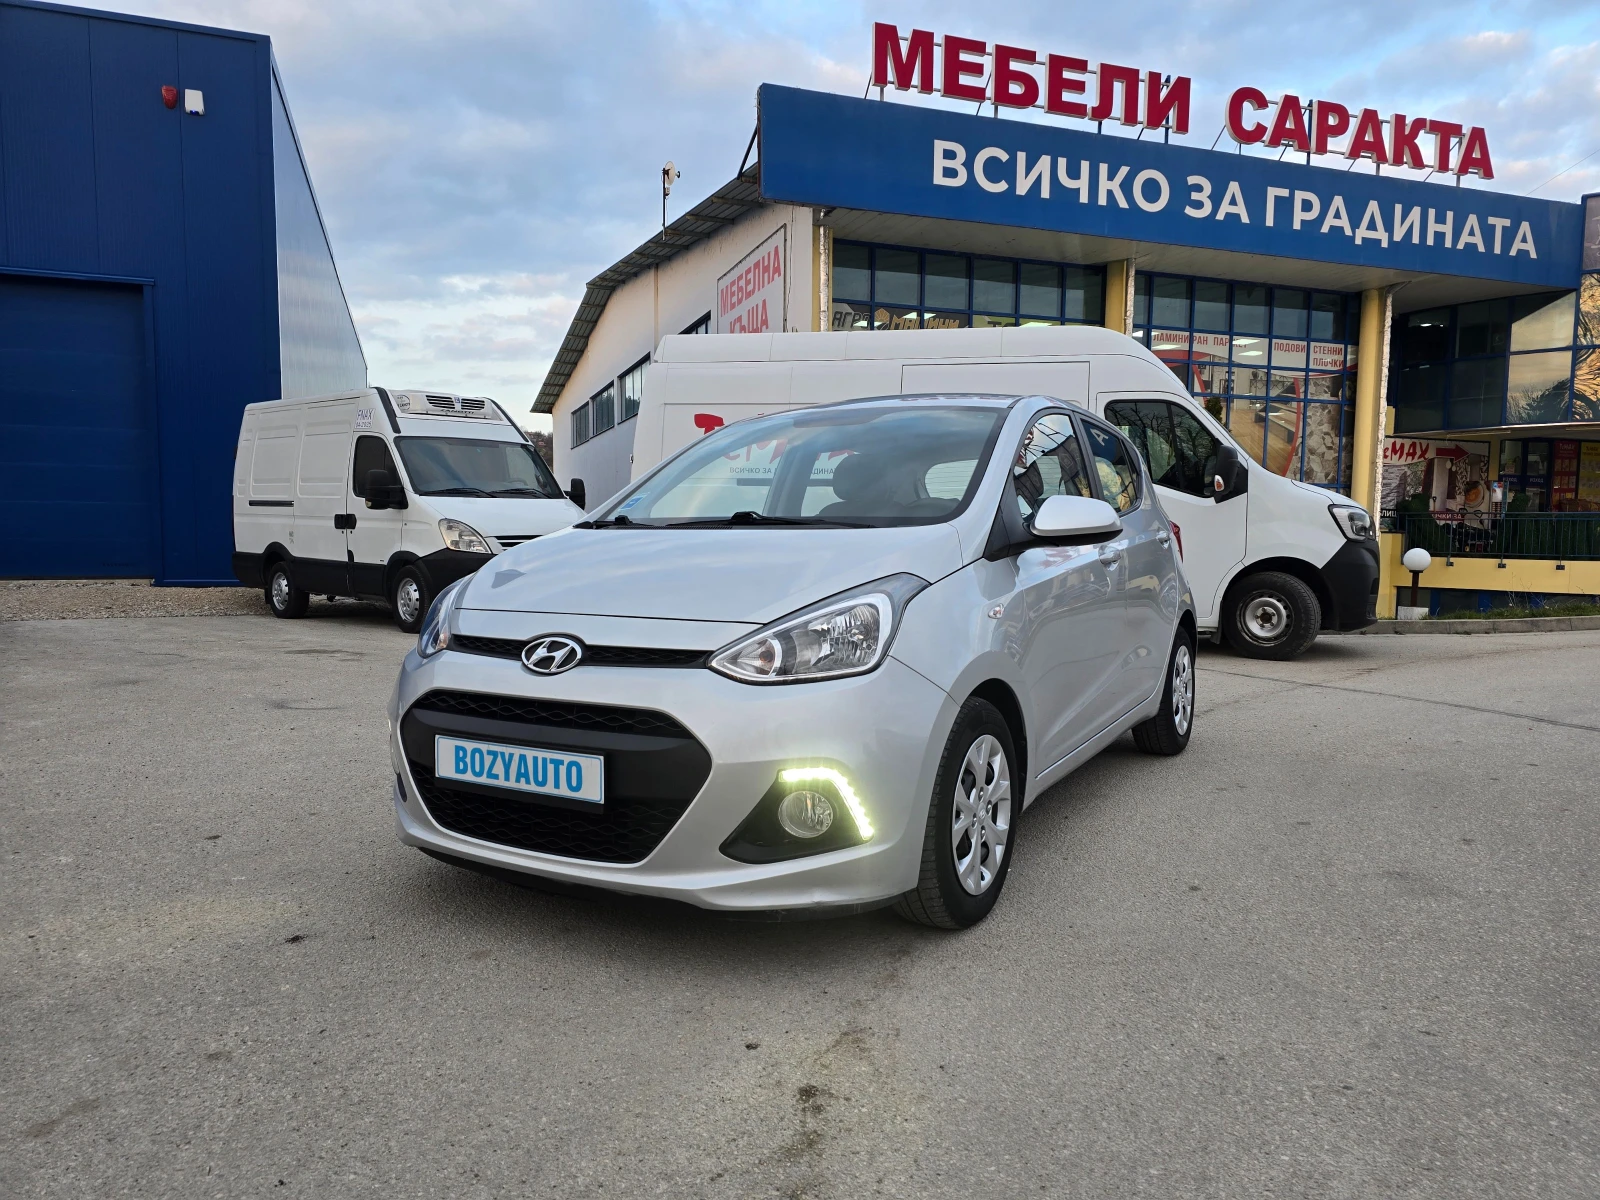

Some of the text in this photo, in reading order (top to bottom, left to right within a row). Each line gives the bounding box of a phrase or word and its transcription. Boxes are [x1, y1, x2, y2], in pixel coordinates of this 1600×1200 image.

[872, 22, 1494, 180] МЕБЕЛИ САРАКТА
[933, 139, 1537, 259] ВСИЧКО ЗА ГРАДИНАТА
[721, 245, 781, 317] МЕБЕЛНА
[730, 298, 769, 334] КЪЩА
[1274, 342, 1343, 355] ПОДОВИ СТЕННИ
[1312, 358, 1344, 367] ПЛОЧКИ
[1383, 440, 1430, 462] eMAX
[454, 744, 583, 793] BOZYAUTO
